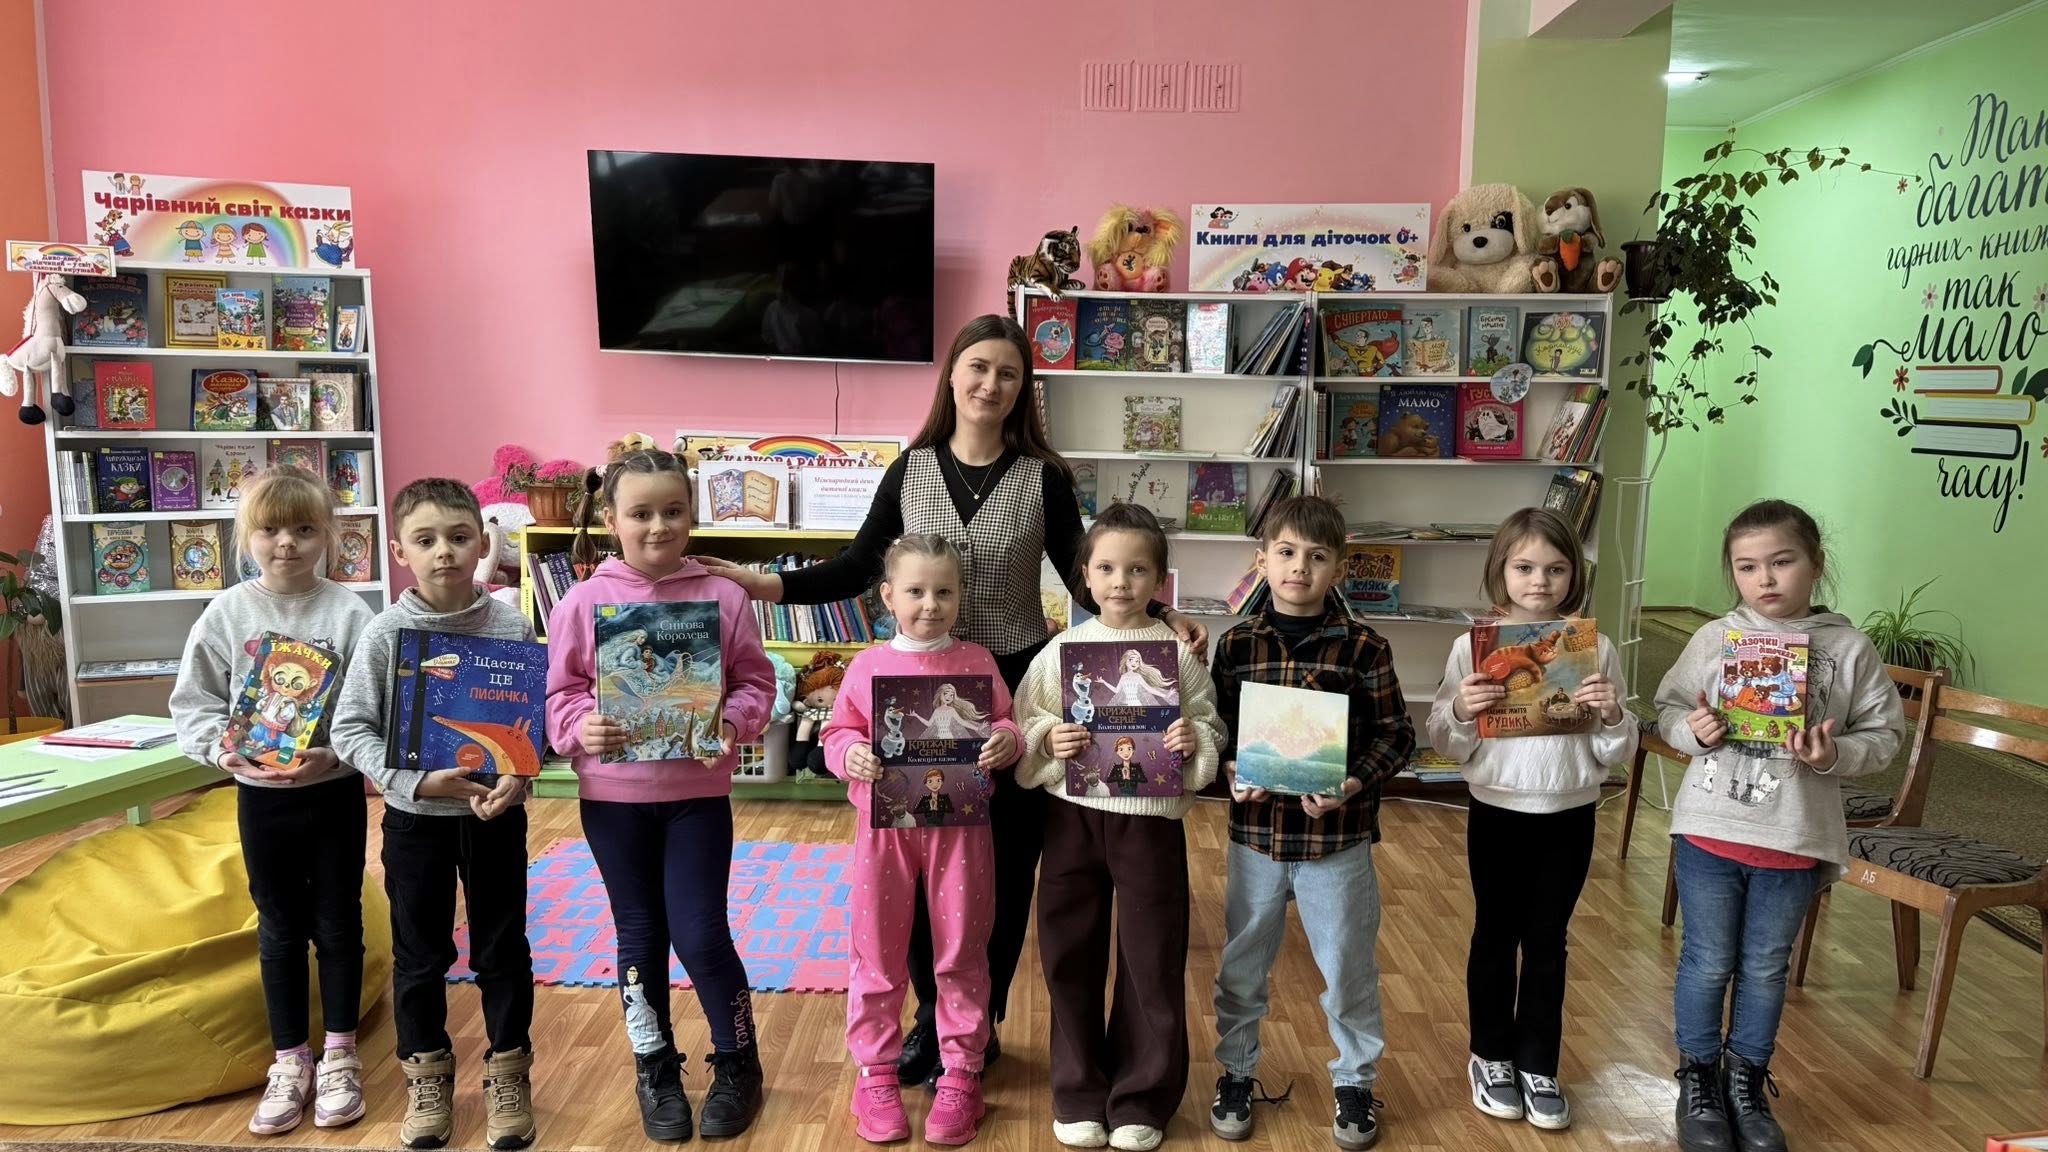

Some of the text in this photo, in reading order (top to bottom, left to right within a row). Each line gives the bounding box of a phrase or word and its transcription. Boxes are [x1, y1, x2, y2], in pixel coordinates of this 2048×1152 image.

[94, 191, 351, 222] Чарівний світ казки
[1196, 230, 1419, 247] Книги для діточок 0+
[1887, 237, 1973, 289] гарних
[1942, 270, 2021, 312] так
[1333, 310, 1389, 329] СУПЕРТАТО
[1901, 311, 2048, 363] мало
[209, 374, 248, 384] Казки
[1397, 397, 1441, 408] МАМО
[797, 454, 865, 467] РАЙДУГА
[659, 619, 705, 631] Снігова
[656, 630, 709, 643] Королева
[1732, 637, 1778, 651] Казочки
[270, 639, 333, 669] ЇЖАЧКИ
[474, 655, 526, 671] Щастя
[489, 673, 513, 686] ЦЕ
[1097, 707, 1148, 717] КРИЖАНЕ
[1108, 715, 1137, 724] СЕРЦЕ
[1487, 715, 1534, 730] РУДИКА
[908, 739, 959, 751] КРИЖАНЕ
[918, 749, 947, 757] СЕРЦЕ
